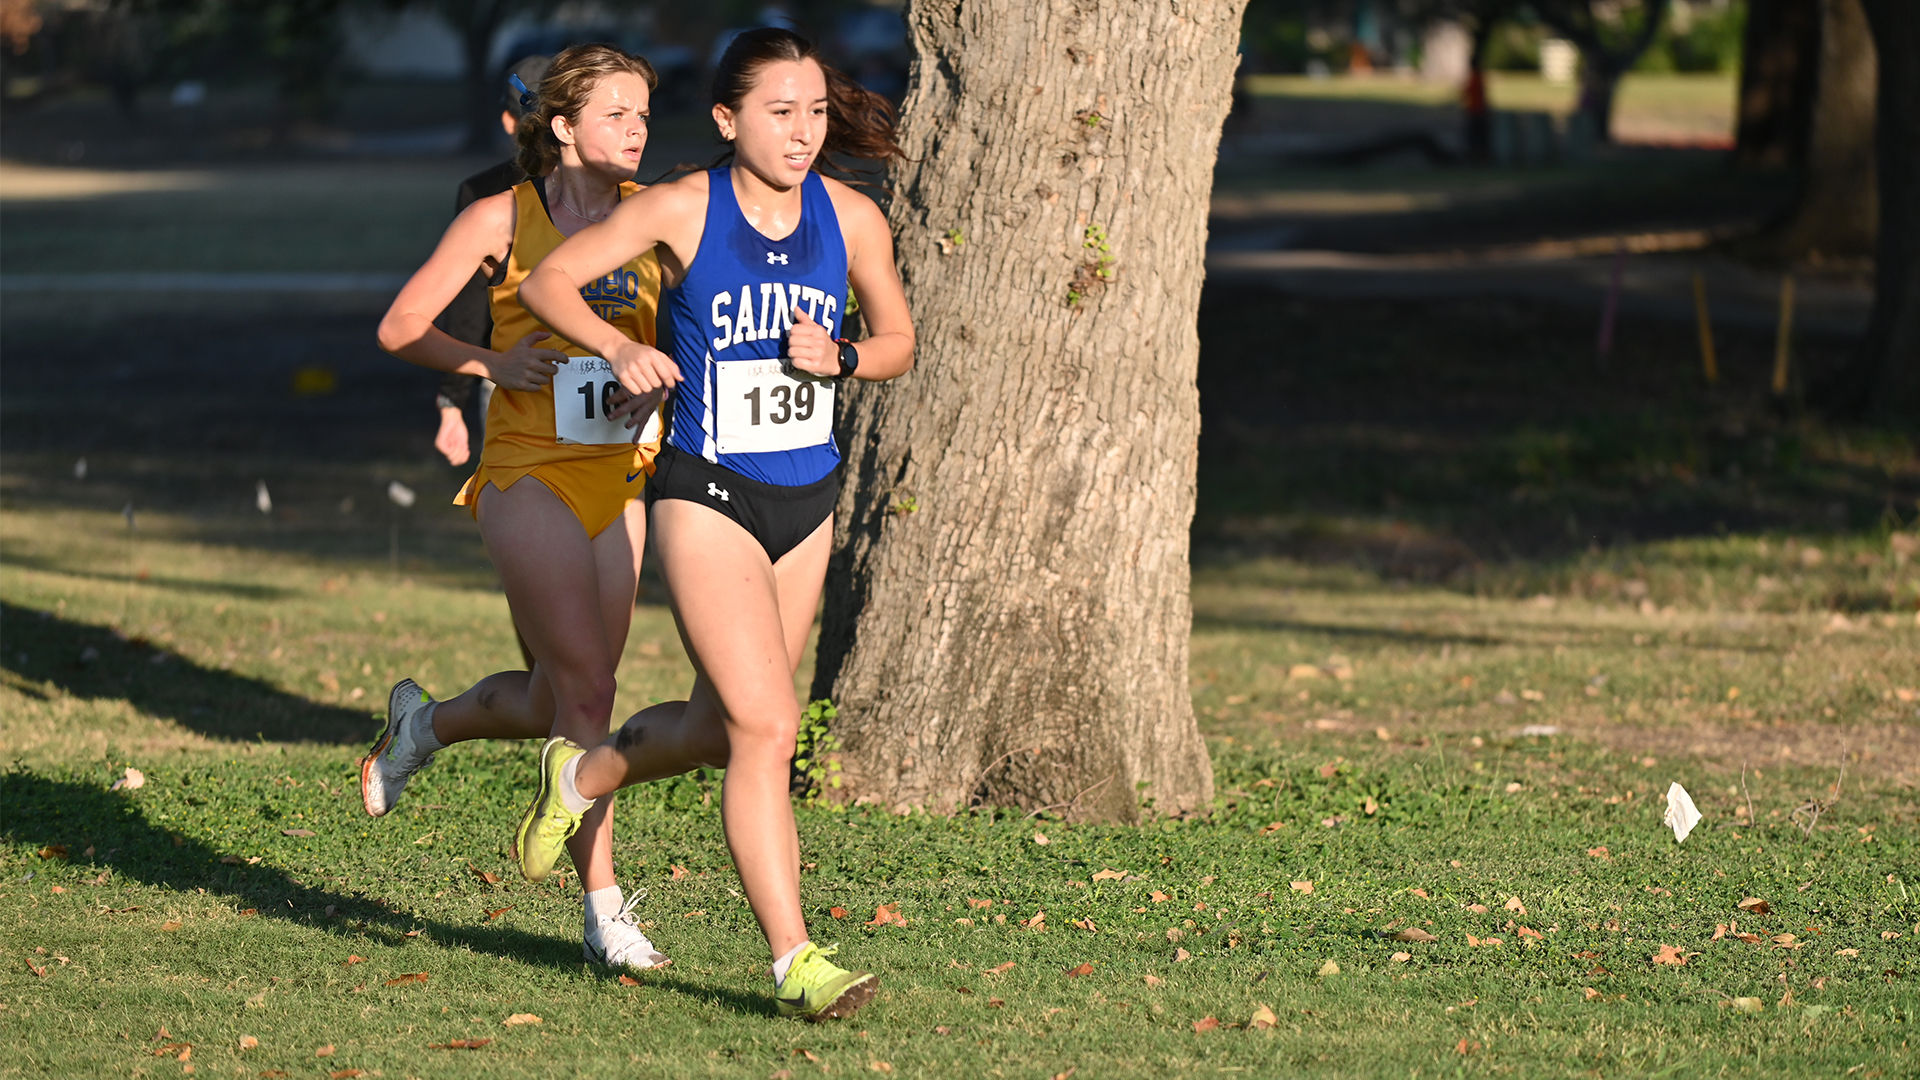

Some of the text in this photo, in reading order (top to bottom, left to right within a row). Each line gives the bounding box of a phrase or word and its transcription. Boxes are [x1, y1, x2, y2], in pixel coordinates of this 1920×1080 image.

[580, 266, 639, 301] gelo
[591, 304, 624, 320] ATE
[711, 282, 837, 351] SAINTS
[577, 381, 638, 420] 10
[743, 381, 816, 426] 139
